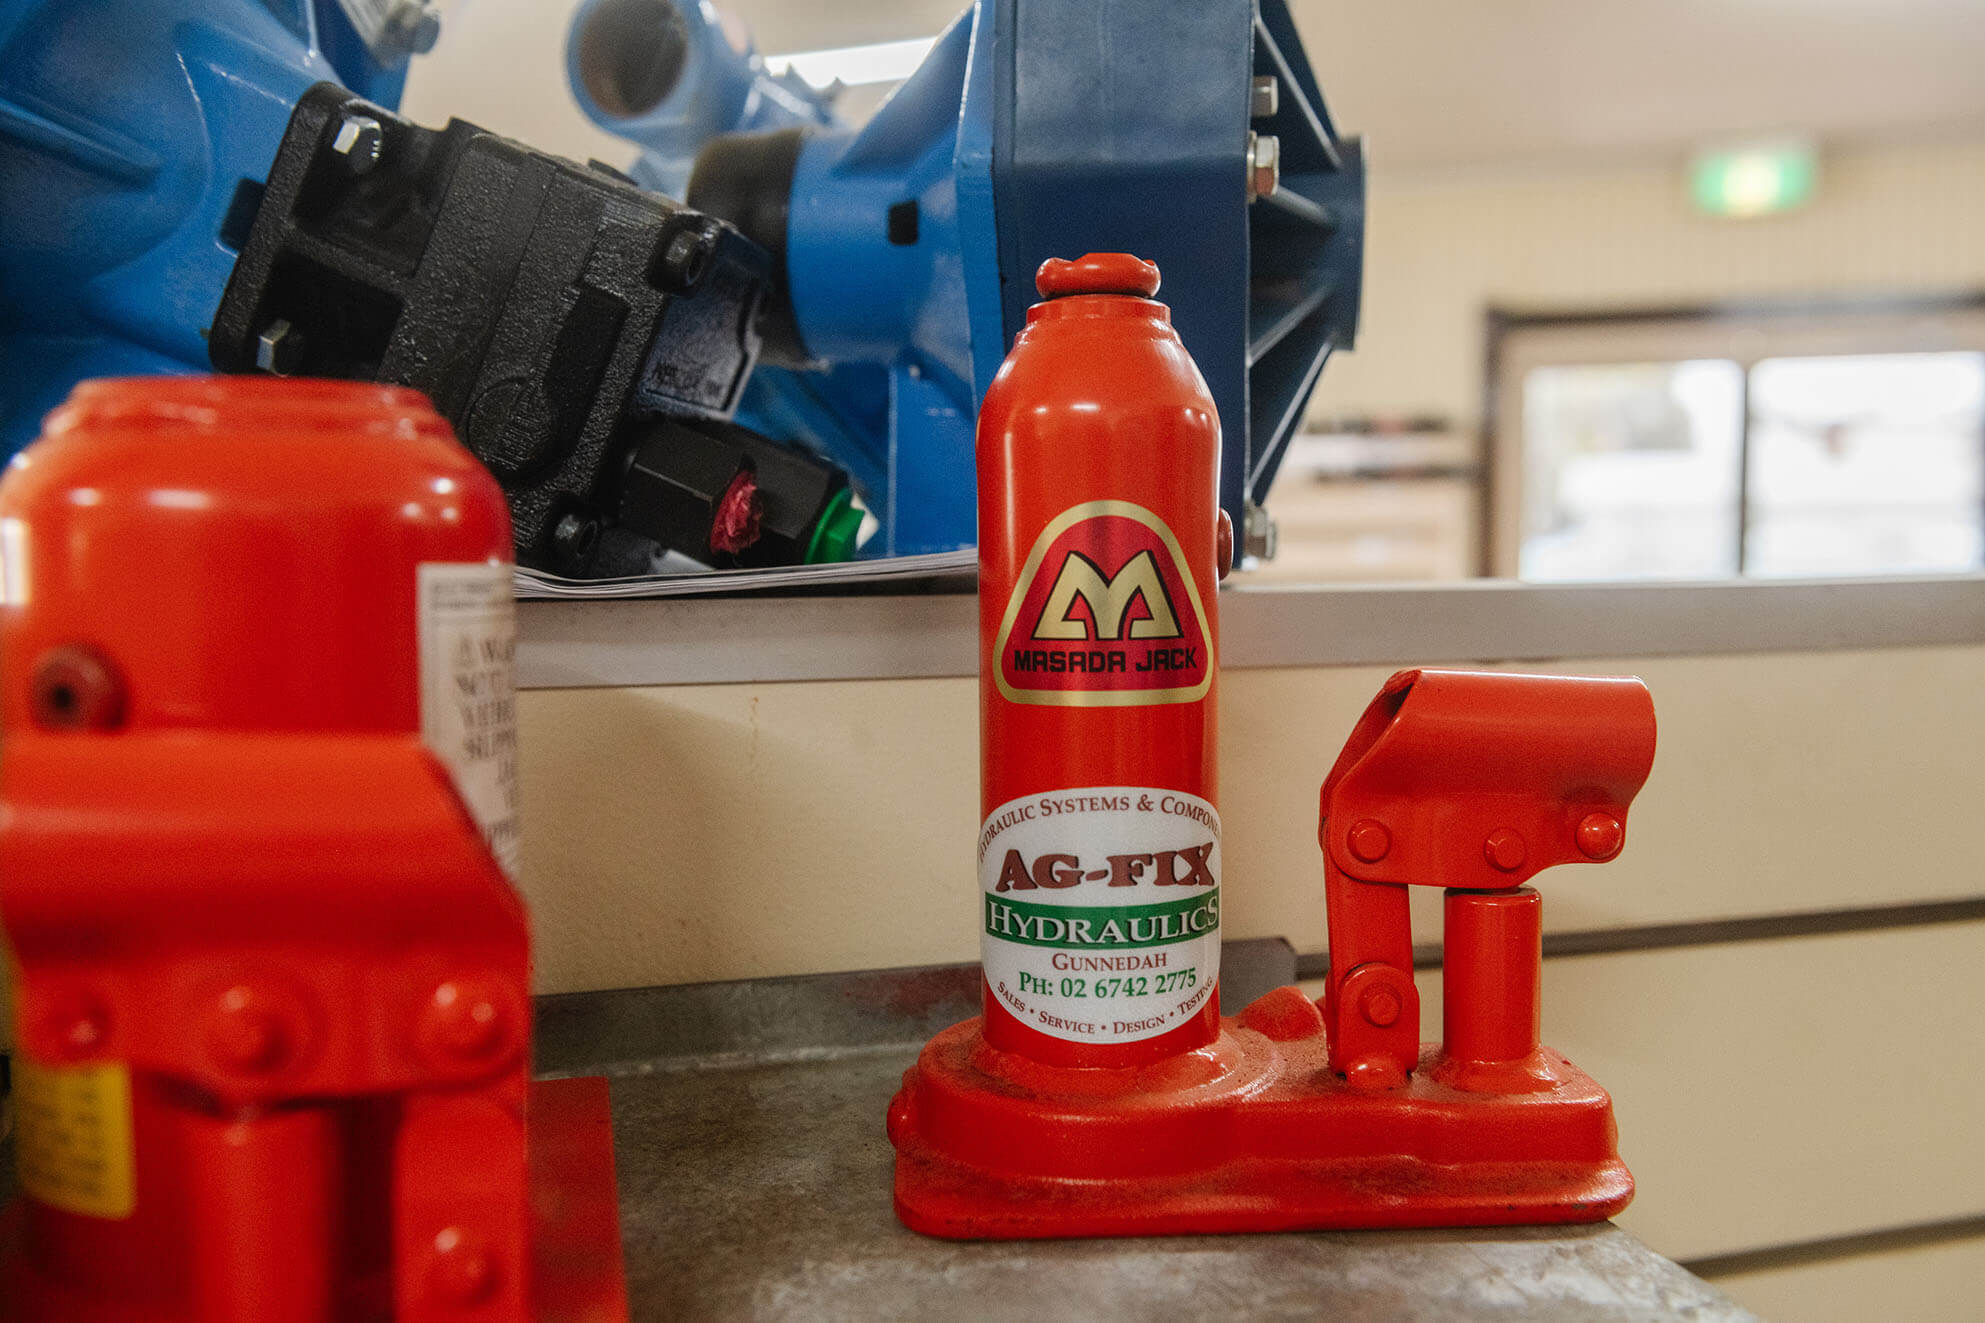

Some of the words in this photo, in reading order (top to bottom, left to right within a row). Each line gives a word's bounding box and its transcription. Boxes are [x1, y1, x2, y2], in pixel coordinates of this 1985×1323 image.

[1014, 650, 1126, 673] MASADA
[1135, 647, 1197, 672] JACK
[1040, 797, 1130, 816] SYSTEMS
[1137, 794, 1154, 813] &
[995, 841, 1215, 892] AG-FIX
[988, 896, 1218, 944] HYDRAULICS
[1052, 952, 1167, 972] GUNNEDAH
[1019, 971, 1054, 996] PH:
[1061, 978, 1087, 998] 02
[1095, 977, 1149, 998] 6742
[1155, 967, 1197, 994] 2775
[997, 981, 1026, 1012] SALES
[1038, 1011, 1095, 1034] SERVICE
[1113, 1014, 1166, 1034] DESIGN
[1176, 976, 1213, 1016] TESTING
